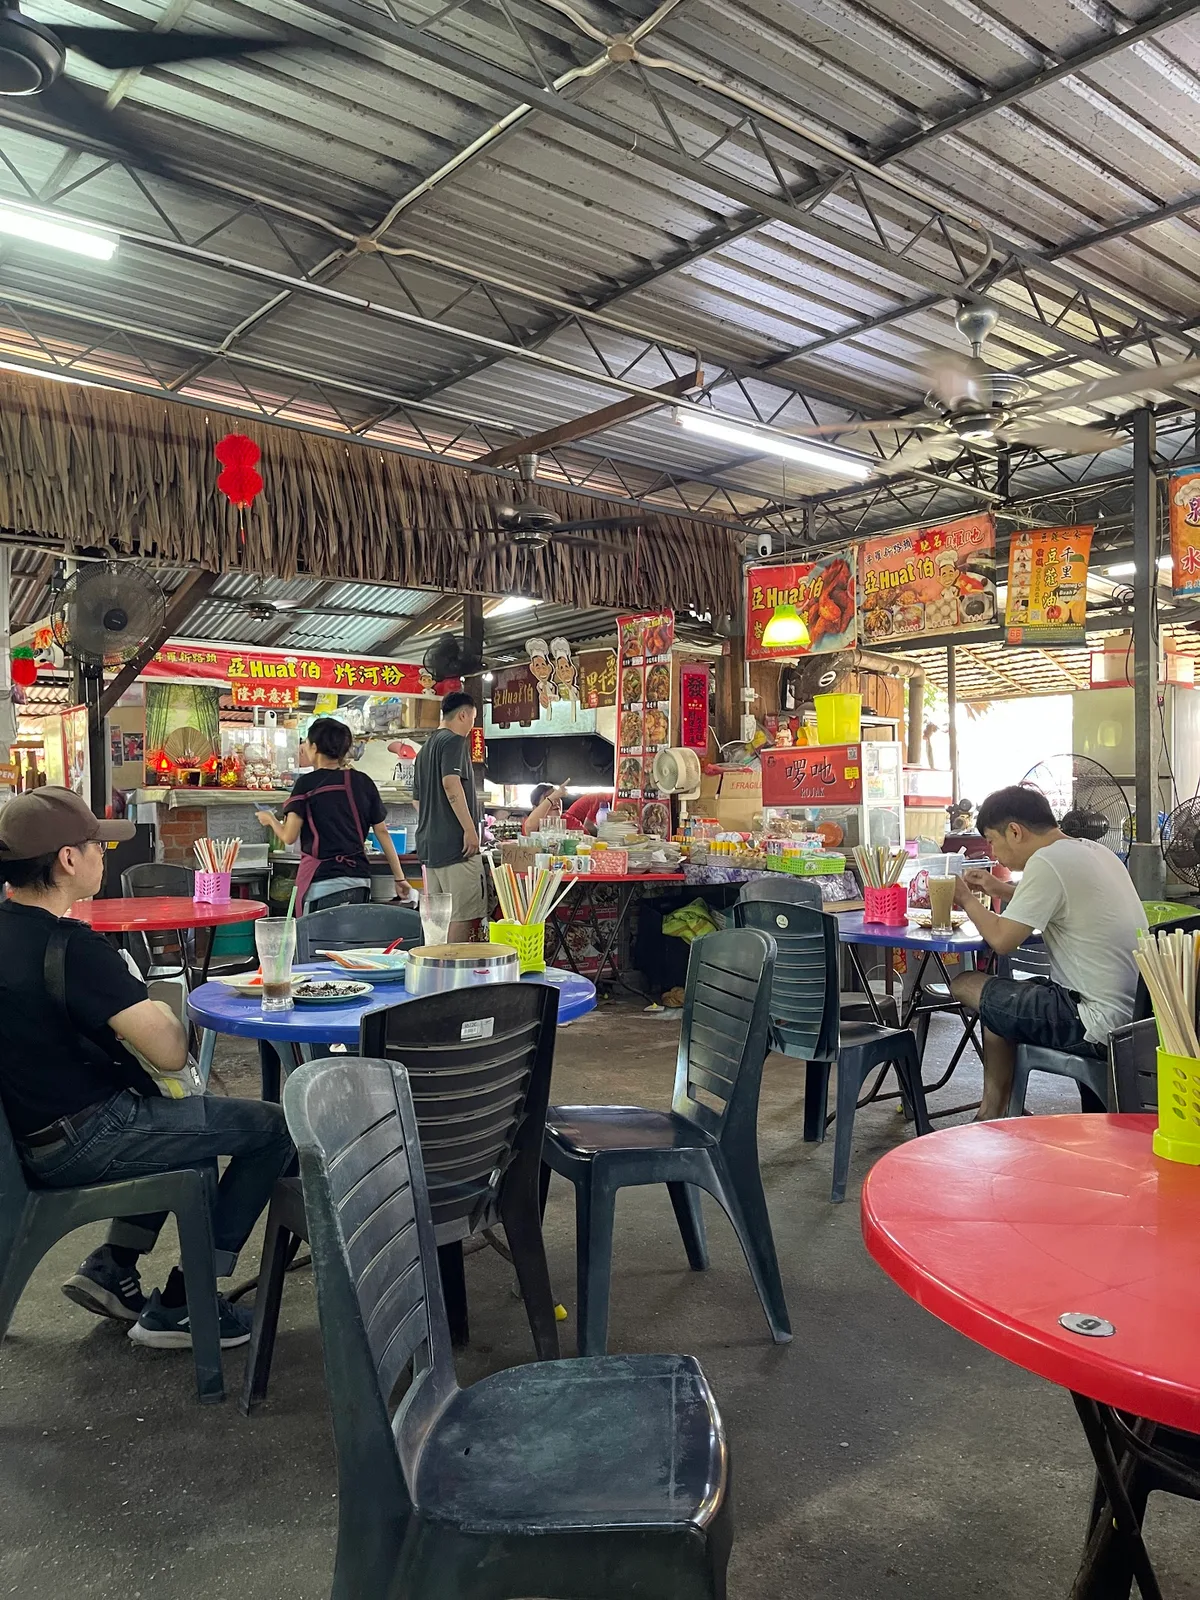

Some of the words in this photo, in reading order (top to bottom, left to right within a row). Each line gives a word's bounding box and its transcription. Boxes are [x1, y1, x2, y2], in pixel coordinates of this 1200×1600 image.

[334, 662, 406, 686] 炸河粉
[801, 787, 825, 798] ROJAK
